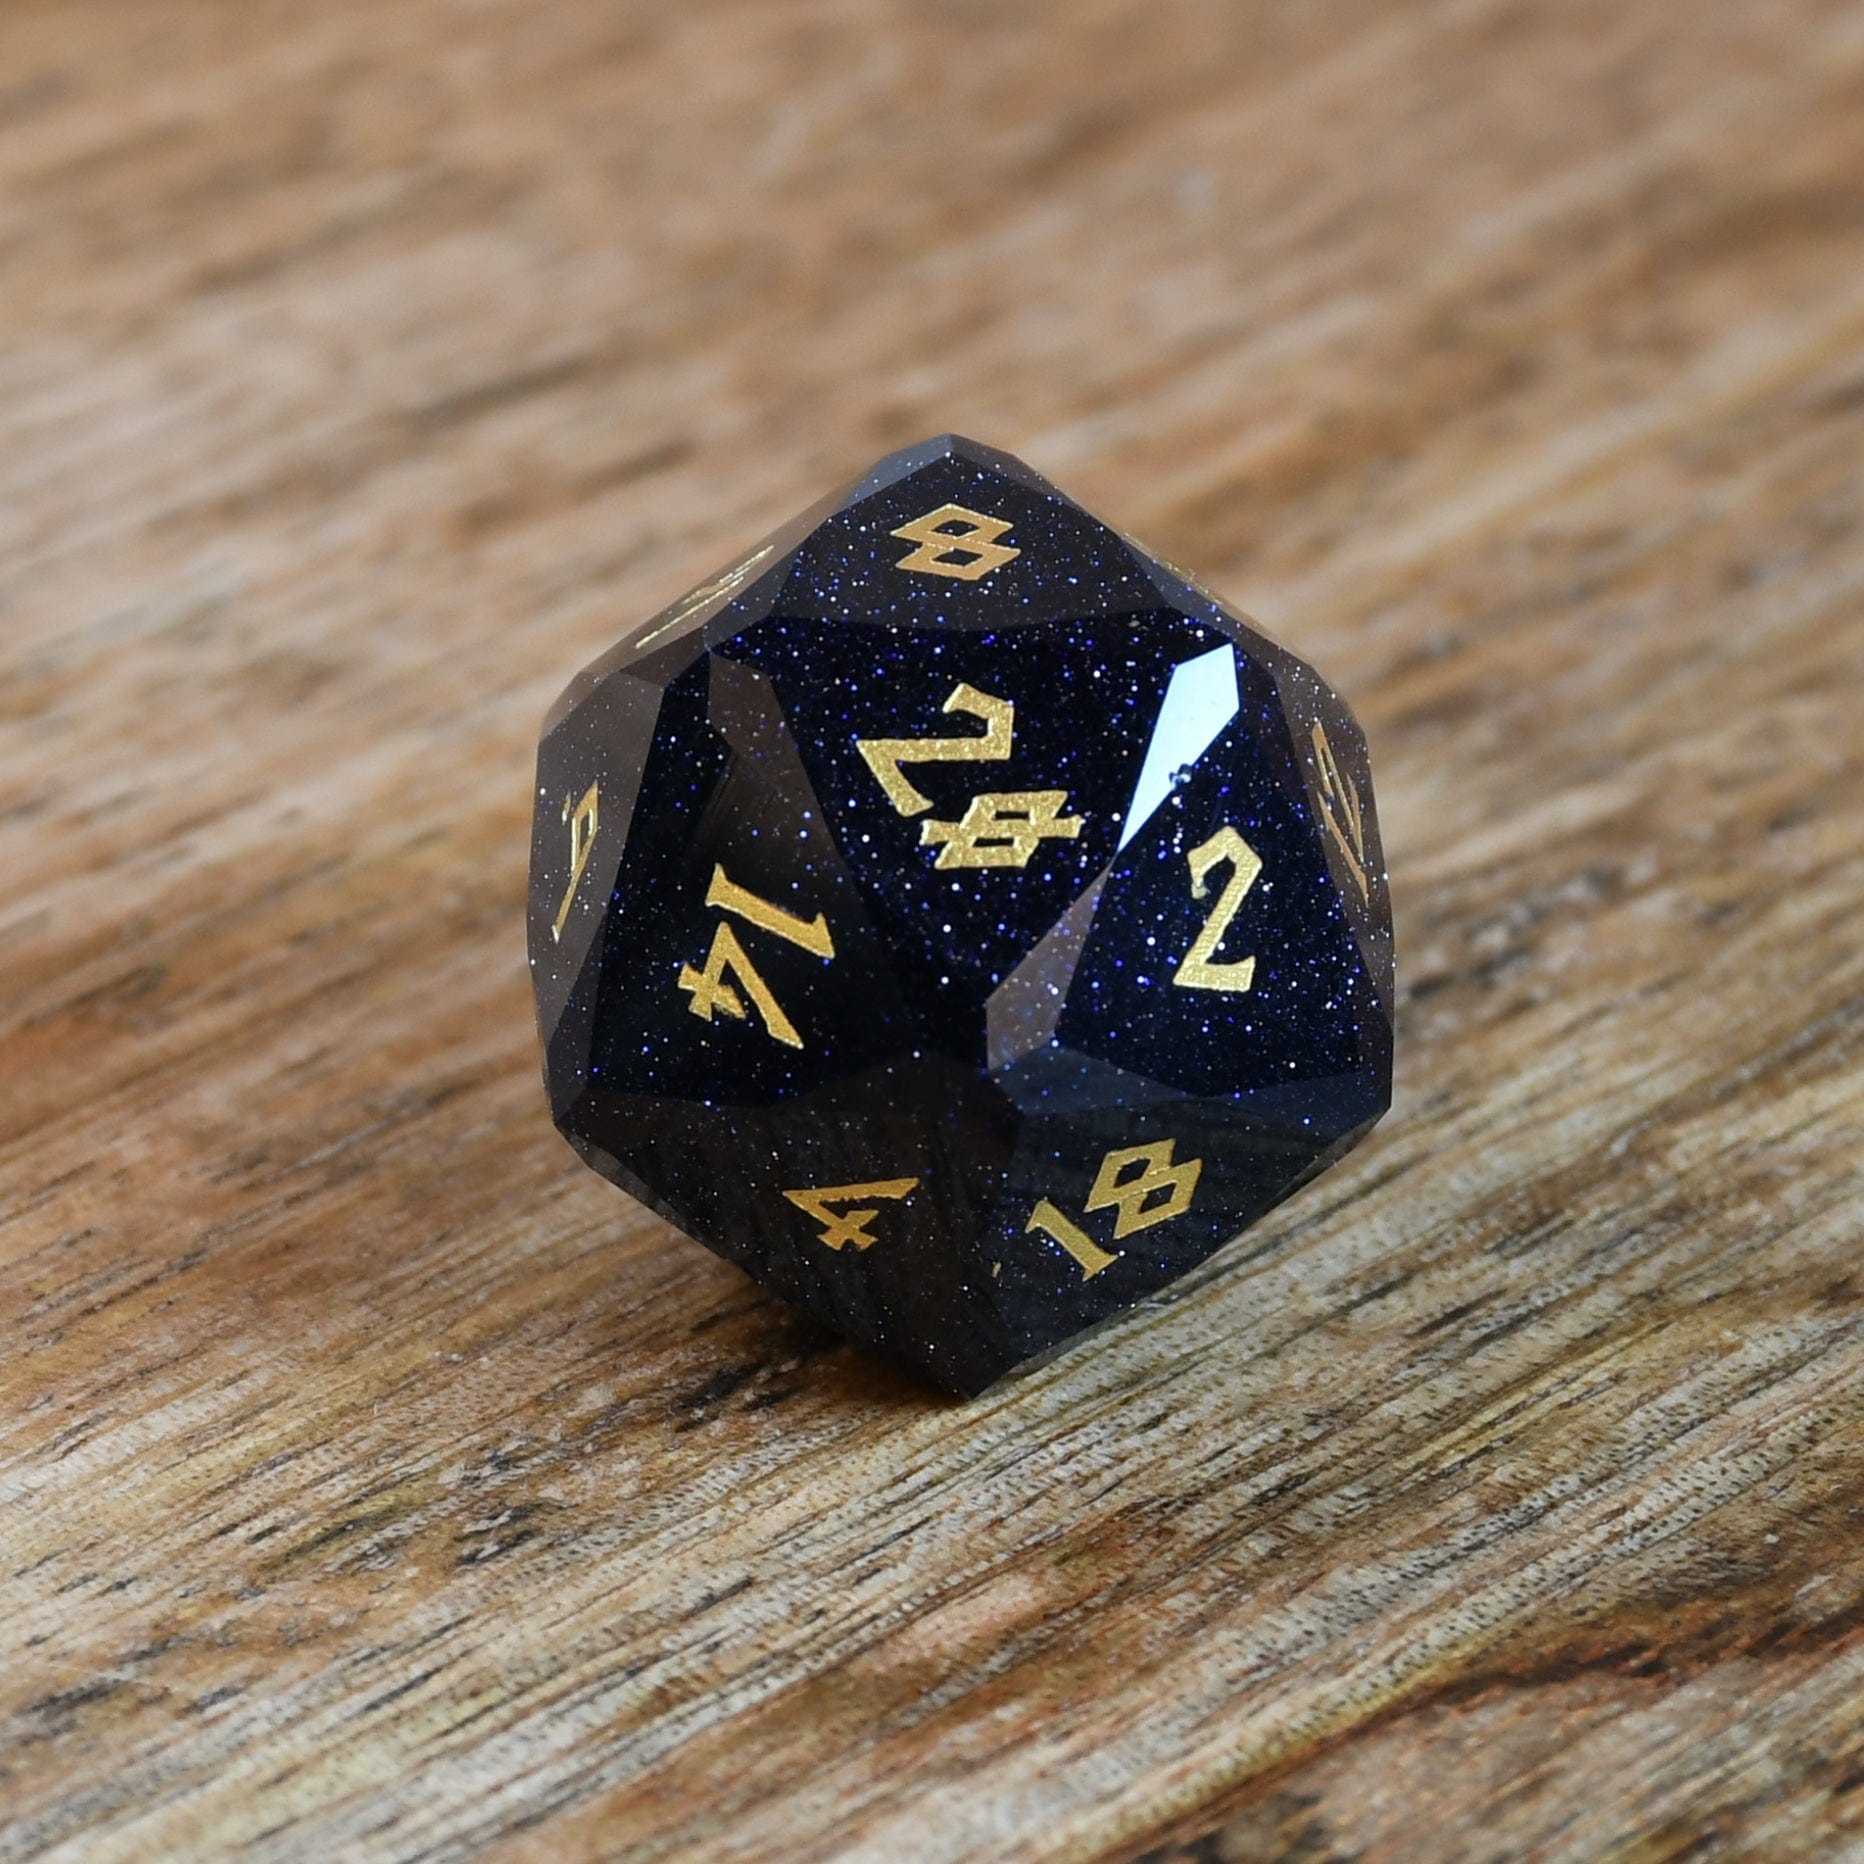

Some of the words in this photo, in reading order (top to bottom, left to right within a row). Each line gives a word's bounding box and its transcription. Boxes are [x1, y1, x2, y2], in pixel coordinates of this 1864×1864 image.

[890, 503, 1021, 581] 8
[678, 863, 836, 1050] 14
[1173, 825, 1263, 992] 2
[782, 1176, 920, 1251] 4
[1024, 1138, 1202, 1283] 18
